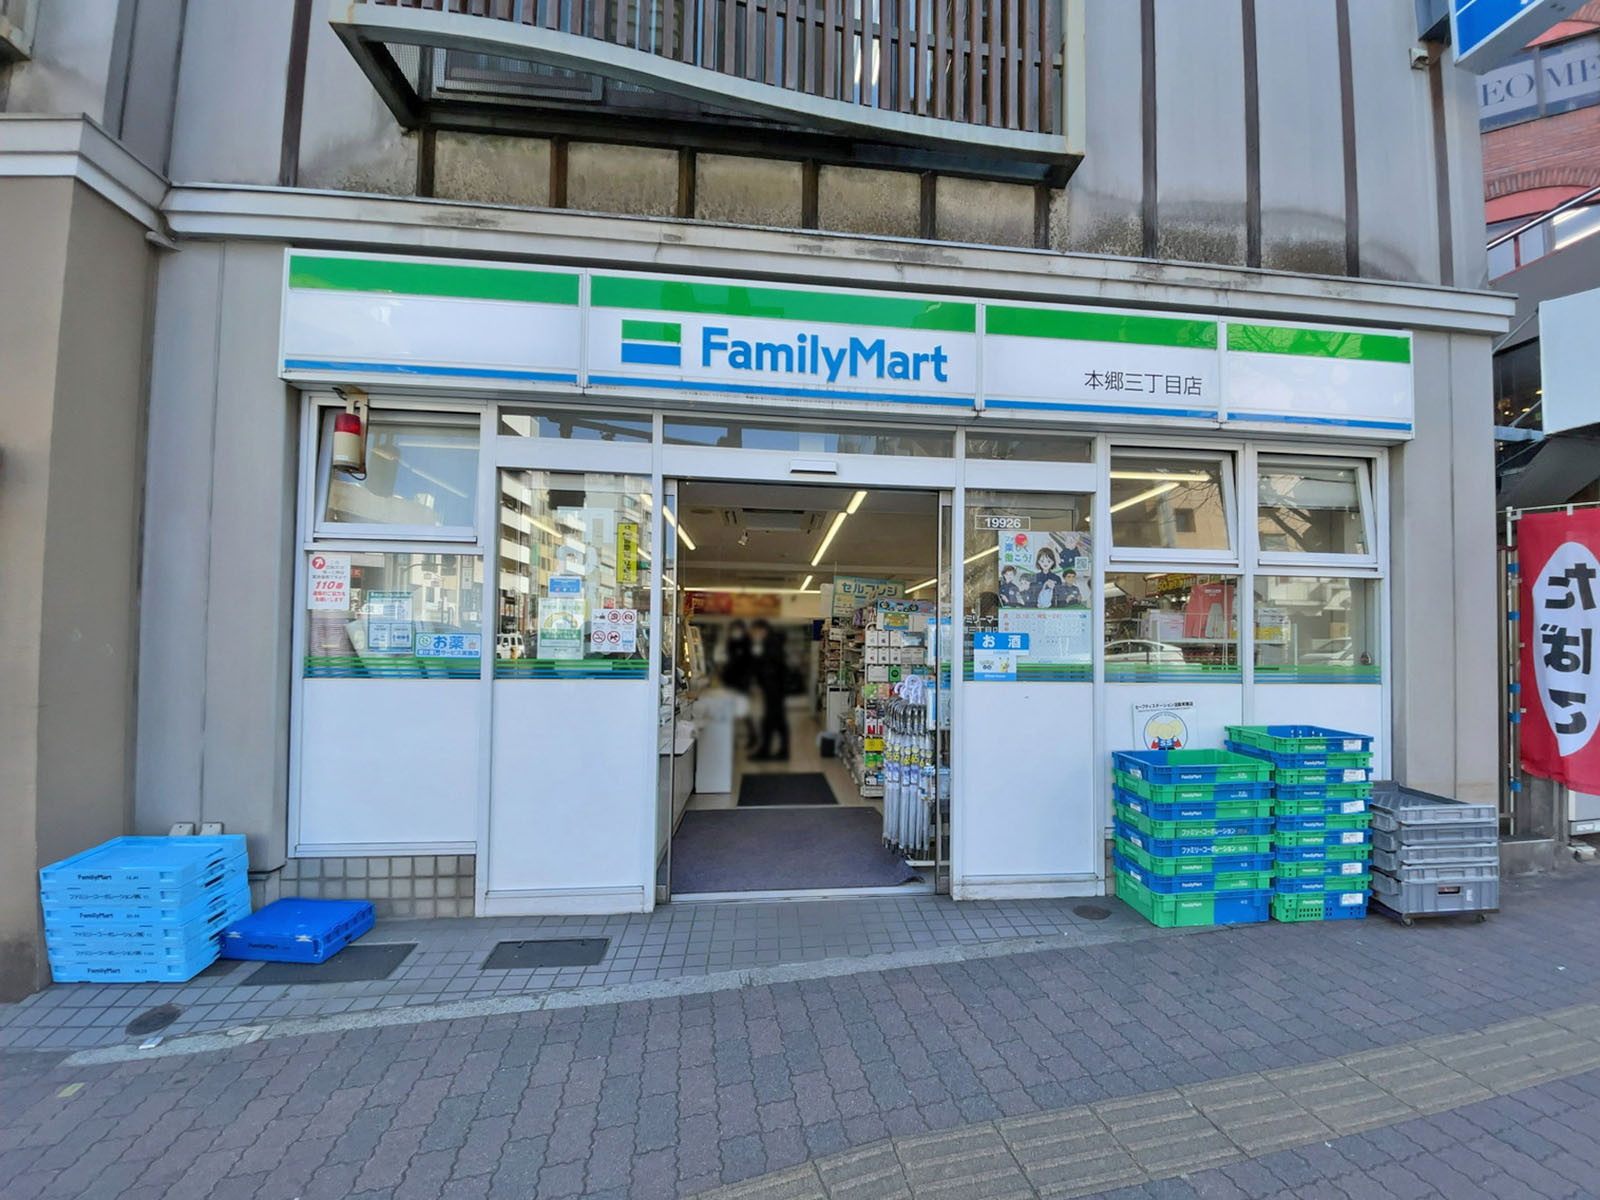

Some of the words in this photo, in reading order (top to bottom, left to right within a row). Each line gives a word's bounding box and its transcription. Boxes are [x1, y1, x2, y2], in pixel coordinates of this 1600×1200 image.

[702, 326, 948, 383] FamilyMart
[1084, 369, 1203, 396] 本郷三丁目店
[984, 517, 1022, 529] 19926
[433, 635, 465, 650] お薬
[982, 634, 1021, 648] お酒
